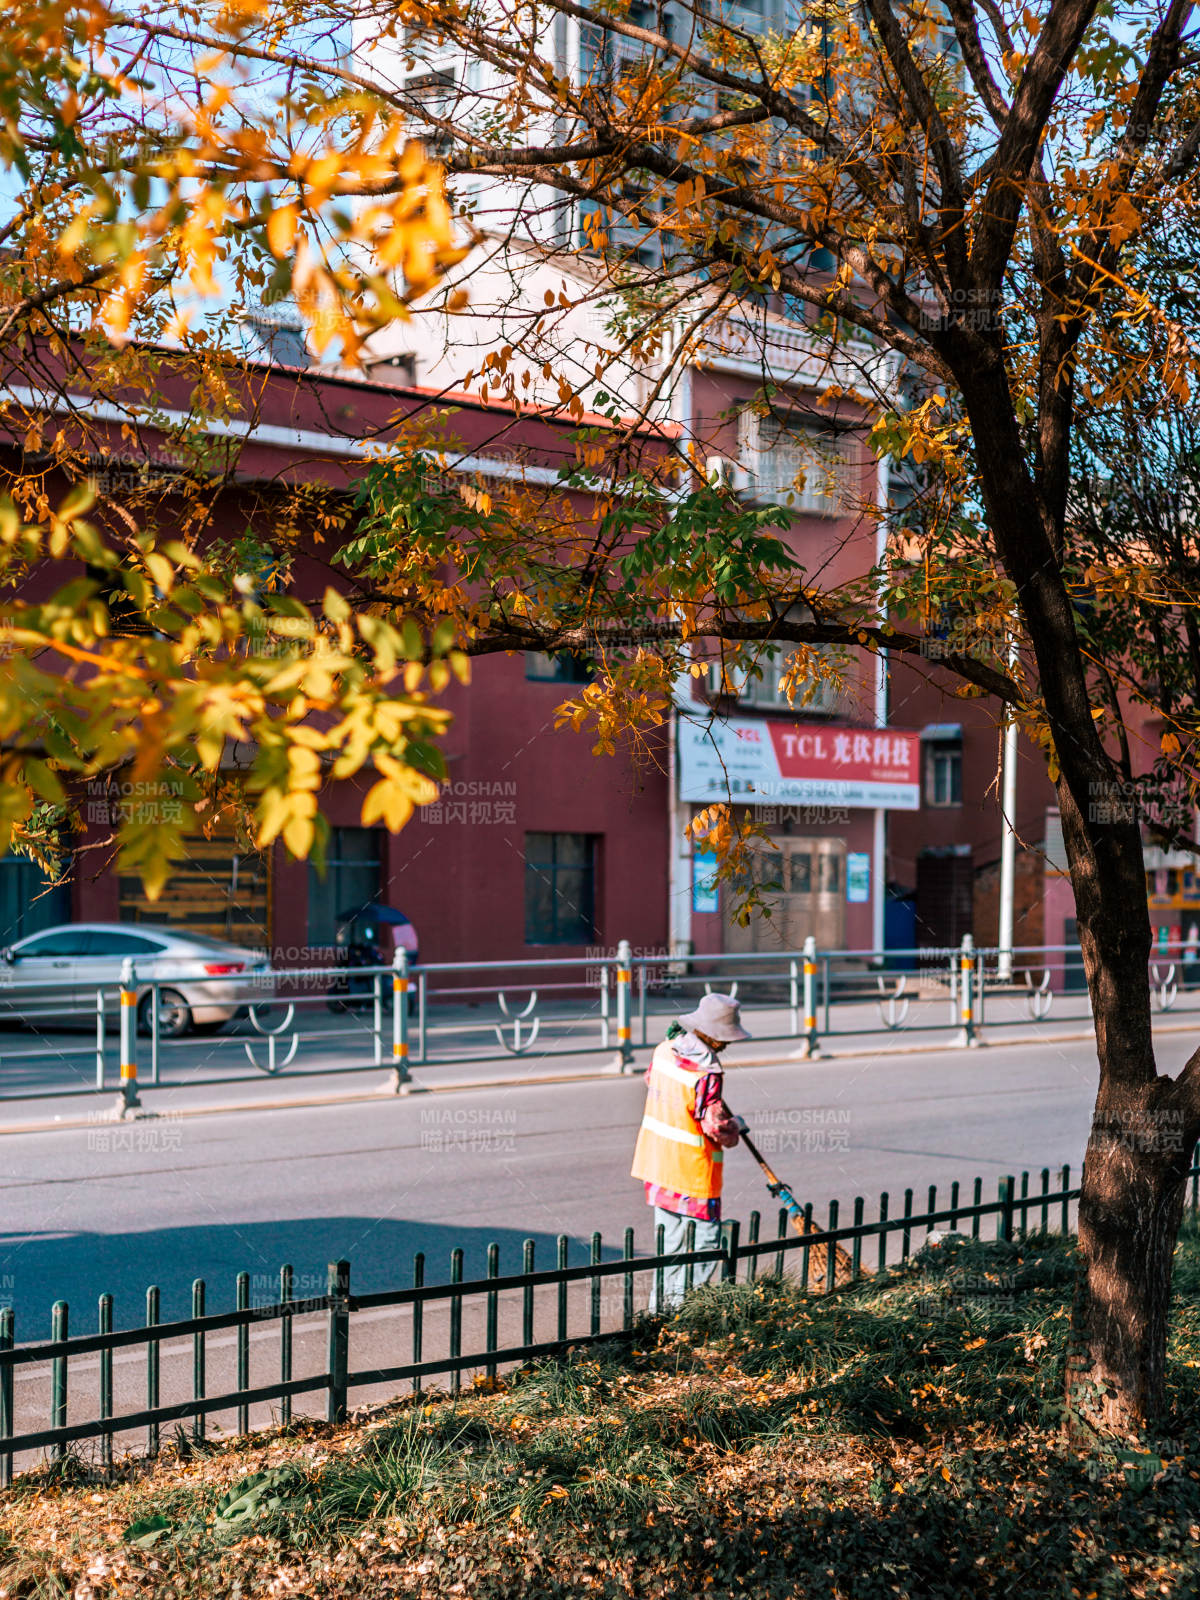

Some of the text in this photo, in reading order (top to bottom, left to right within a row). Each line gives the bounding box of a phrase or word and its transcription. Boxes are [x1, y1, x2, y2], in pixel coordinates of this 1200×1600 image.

[737, 728, 762, 742] TCL
[782, 732, 911, 766] TCL 光伏科技
